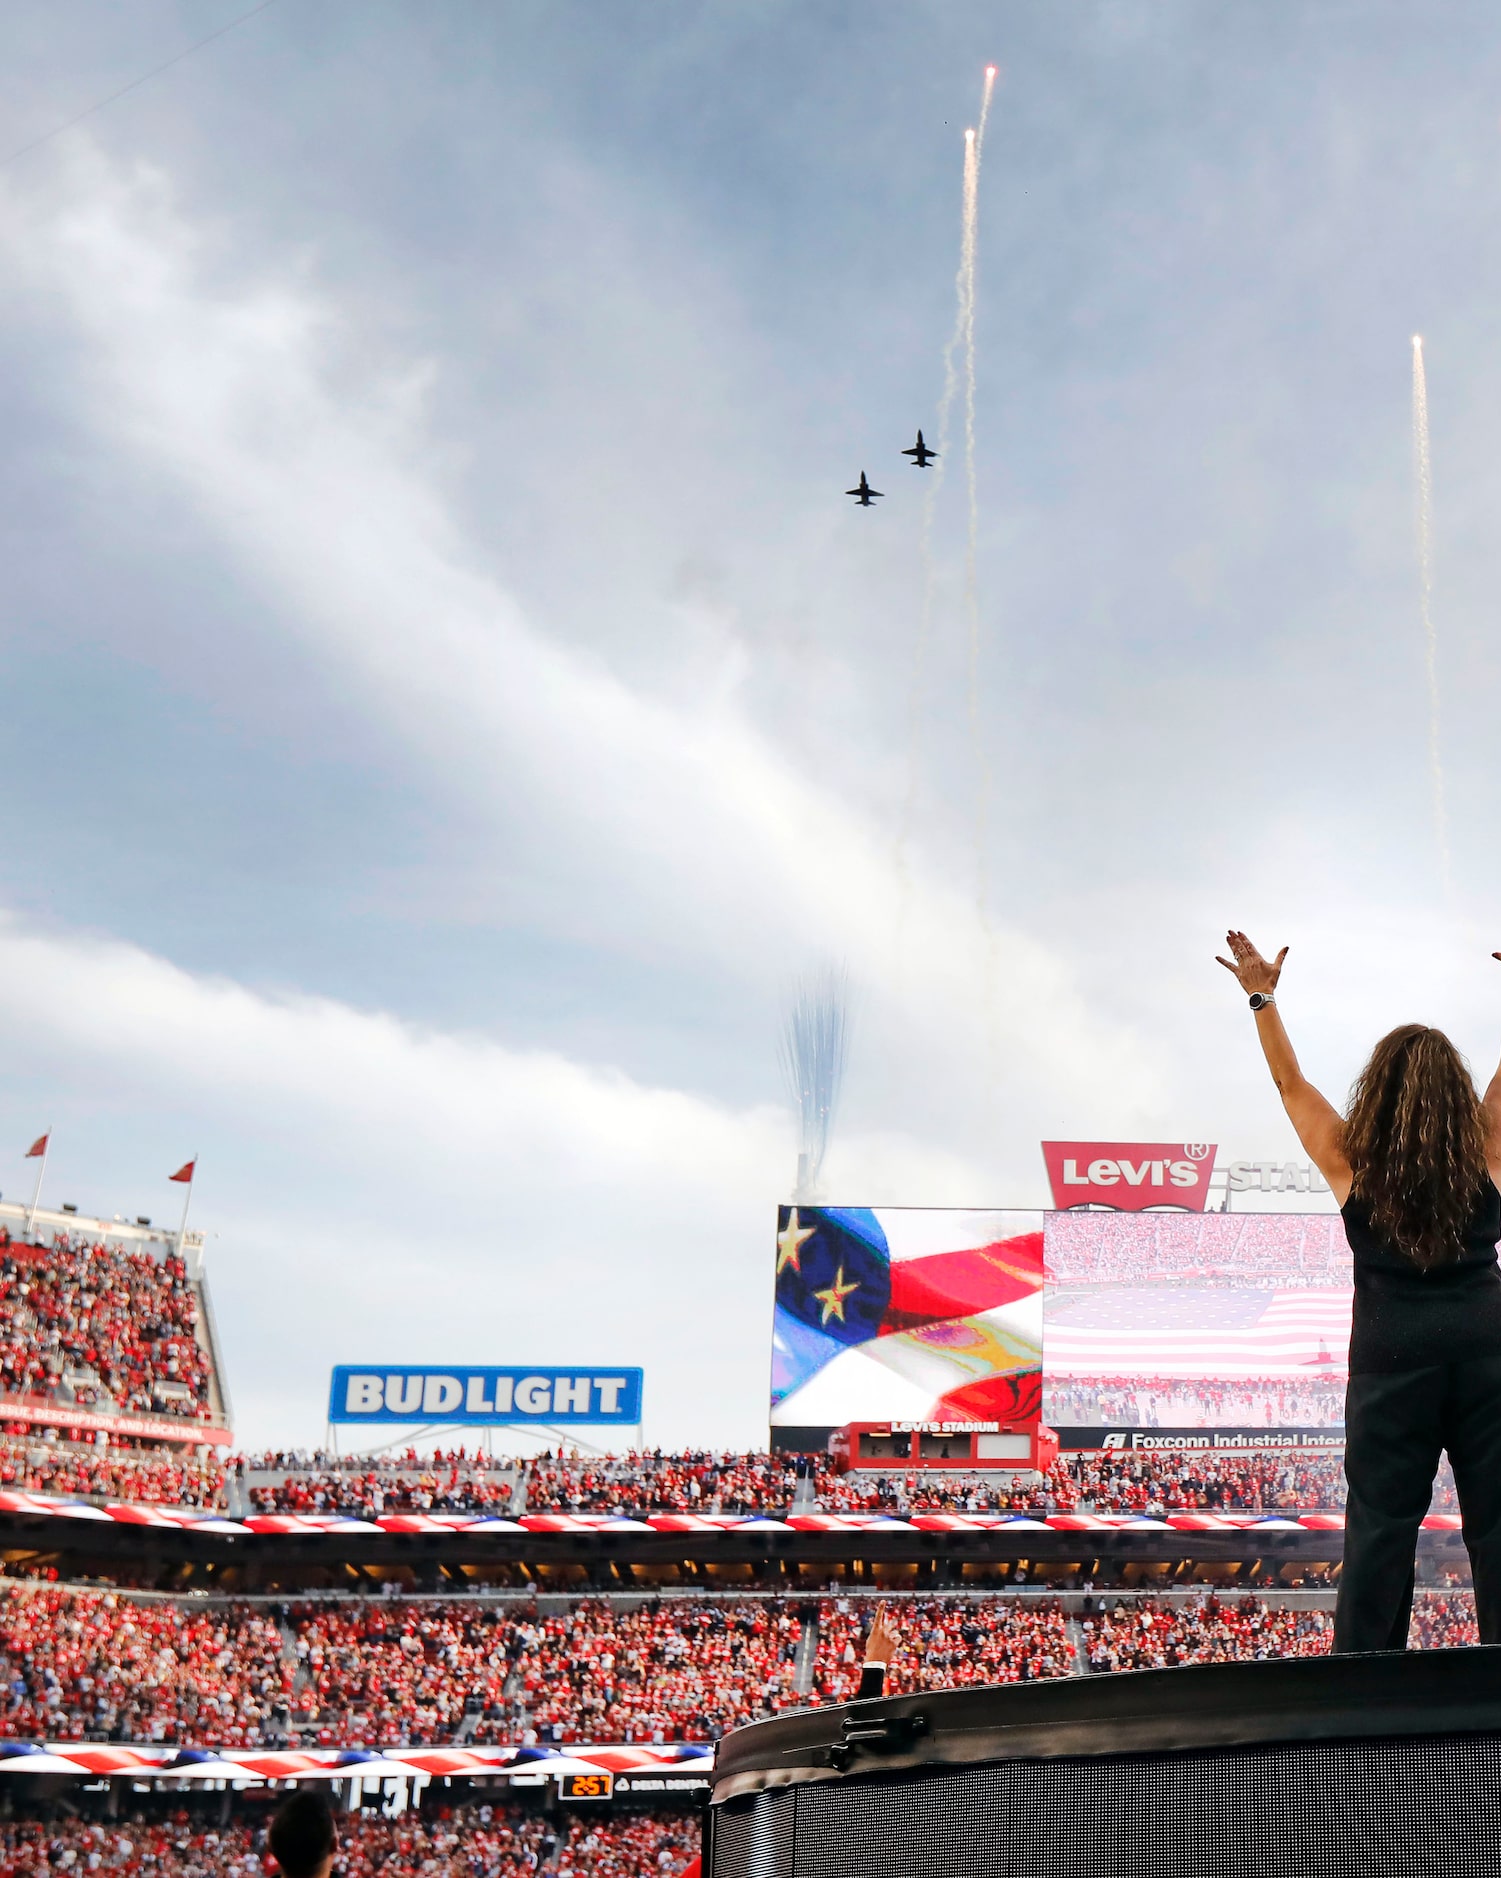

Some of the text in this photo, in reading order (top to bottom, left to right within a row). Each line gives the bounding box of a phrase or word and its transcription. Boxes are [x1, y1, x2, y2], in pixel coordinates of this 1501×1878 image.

[116, 1417, 144, 1434] AND
[941, 1422, 999, 1432] STADIUM
[1132, 1433, 1210, 1449] Foxconn
[1214, 1434, 1298, 1447] Industrial
